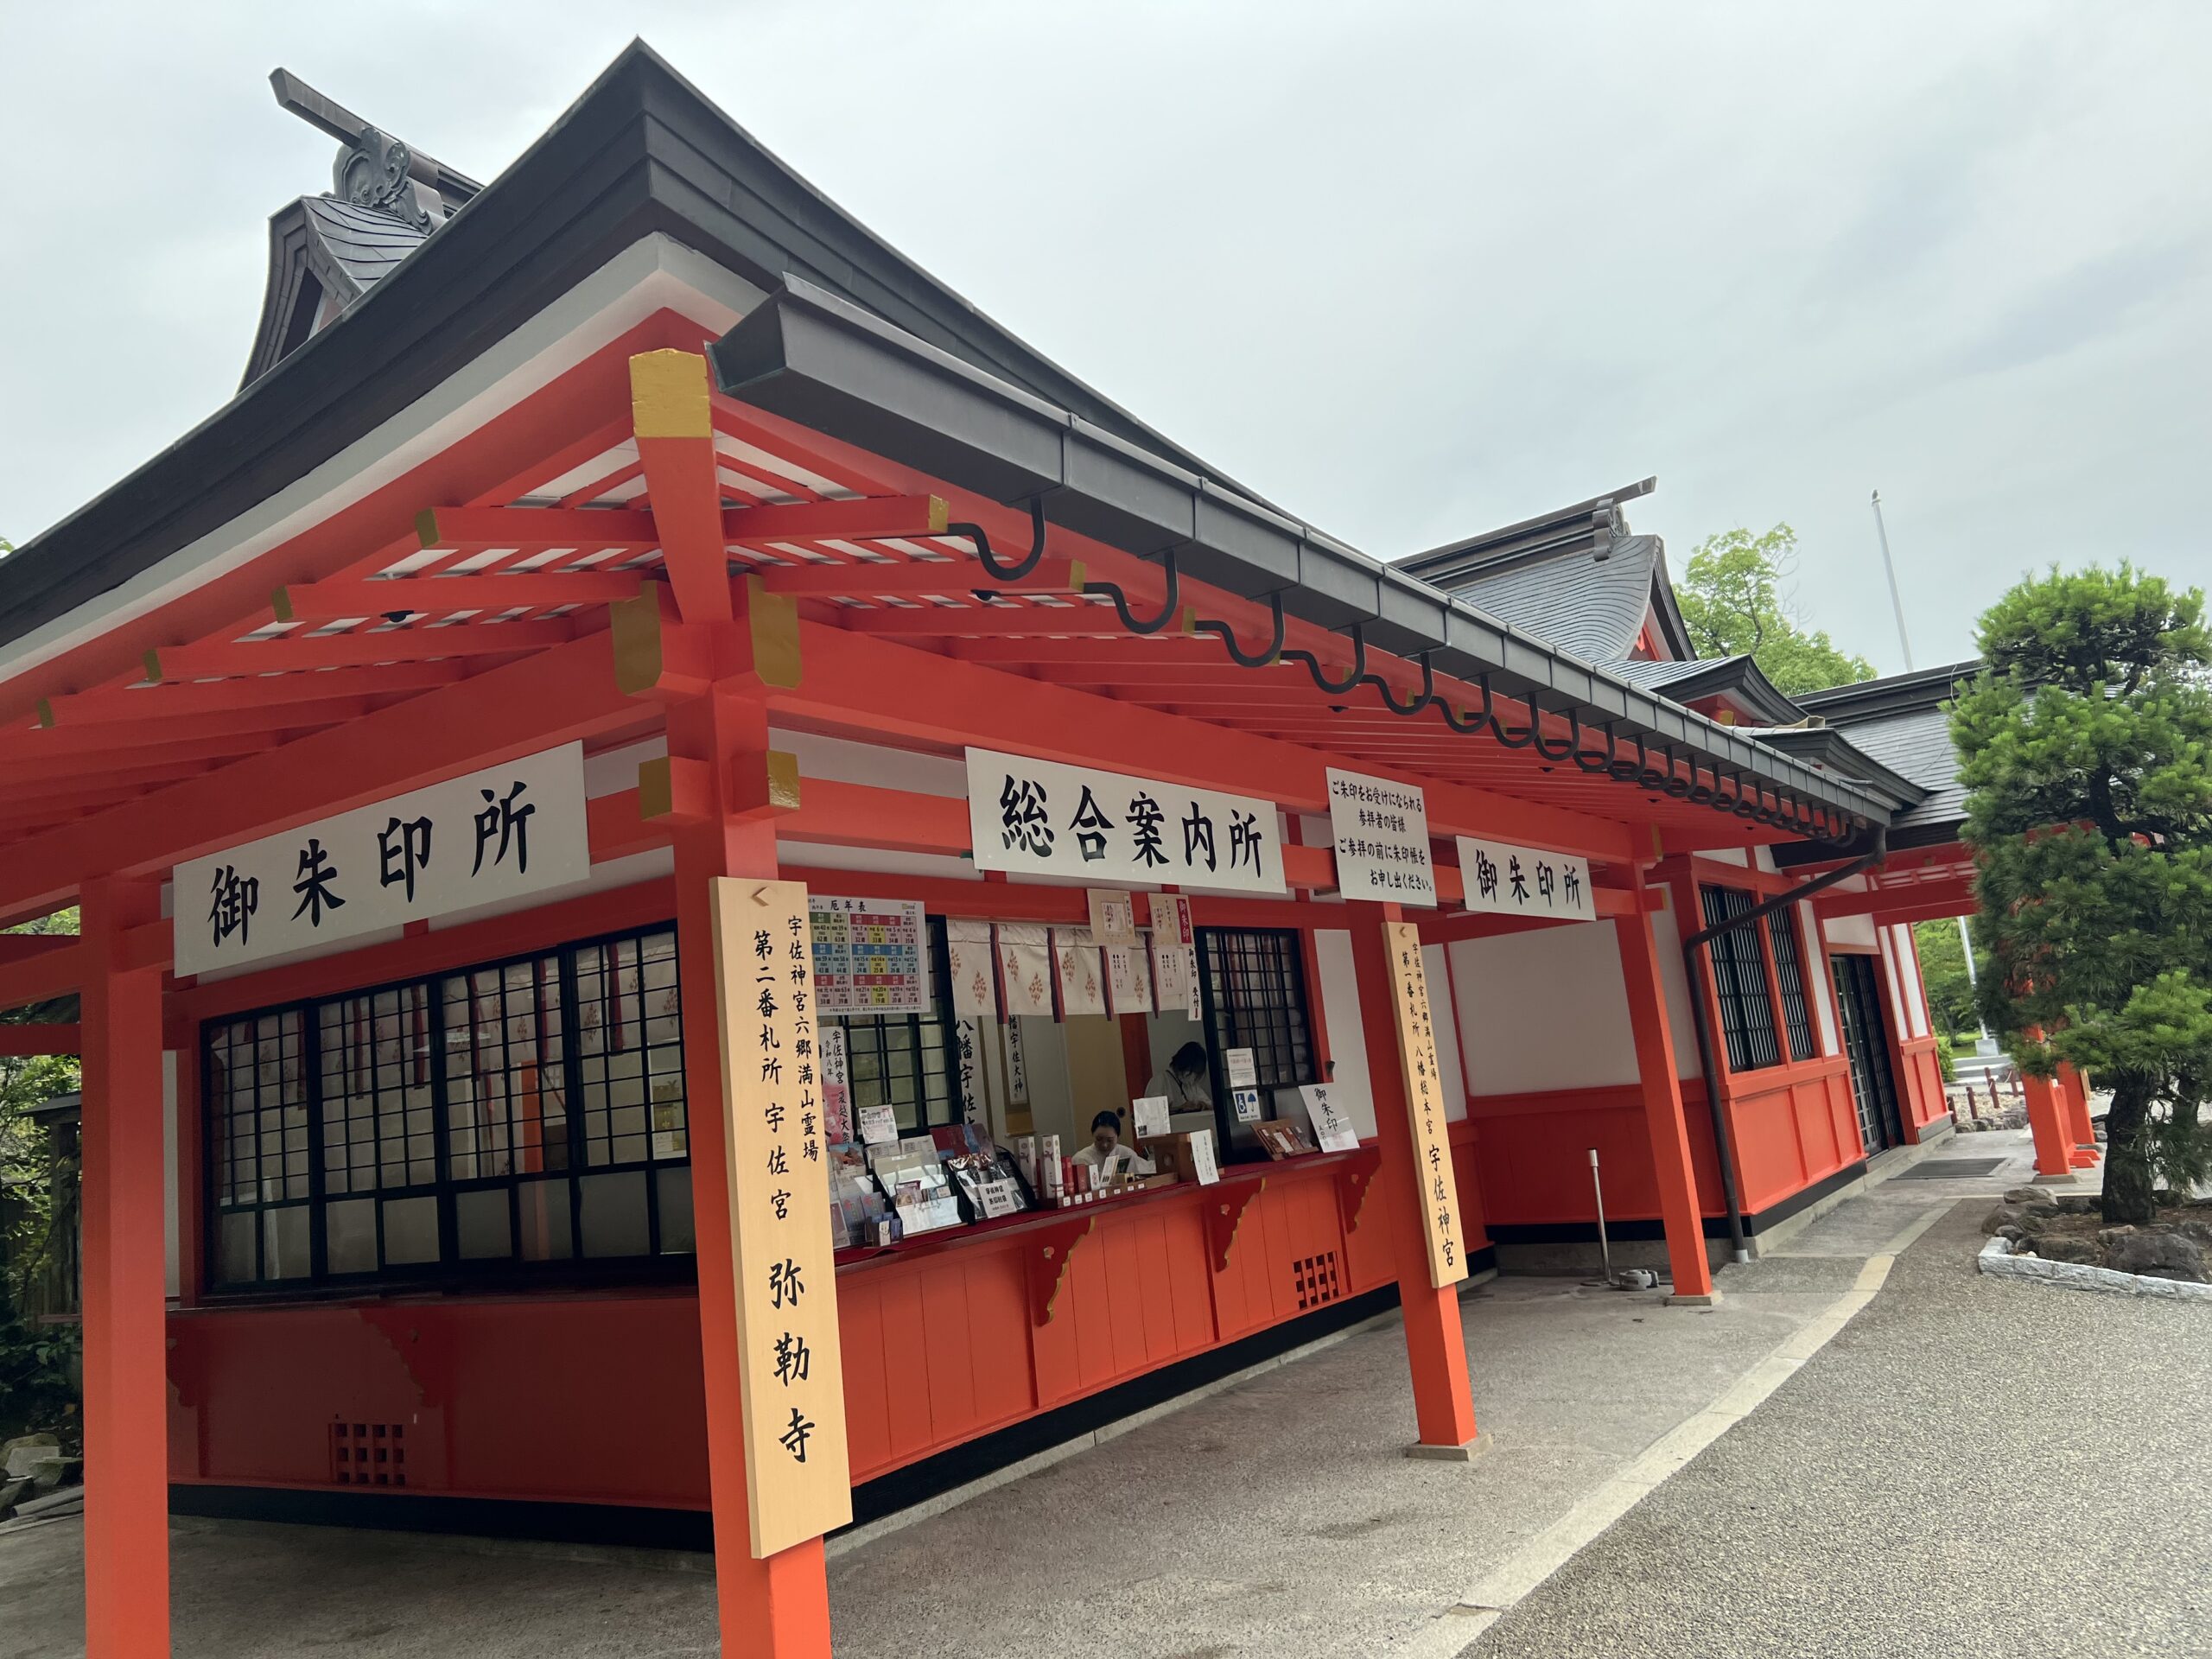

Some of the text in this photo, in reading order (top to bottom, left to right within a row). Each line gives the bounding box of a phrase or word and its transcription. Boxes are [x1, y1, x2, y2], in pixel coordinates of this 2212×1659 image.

[1332, 780, 1422, 812] ご朱印をお受けになられる
[999, 773, 1262, 880] 総合案内所
[1358, 809, 1407, 833] 参拝者の皆様
[207, 781, 536, 948] 御朱印所
[1339, 837, 1426, 866] ご参拝の前に朱印帳を
[1370, 868, 1433, 892] お申し出ください。
[1475, 849, 1580, 910] 御朱印所
[830, 899, 867, 912] 厄年表
[1179, 901, 1190, 941] 御朱印
[1188, 948, 1198, 979] 御朱印
[1412, 942, 1437, 1080] 宇佐神宮六郷満山霊場
[788, 914, 819, 1162] 宇佐神宮六郷満山霊場
[832, 1030, 844, 1084] 宇佐神宮
[1314, 1088, 1338, 1131] 御朱印
[1402, 950, 1454, 1268] 第一番札所 八幡総本宮 宇佐神宮
[753, 930, 815, 1463] 第二番札所 宇佐宮 弥勒寺
